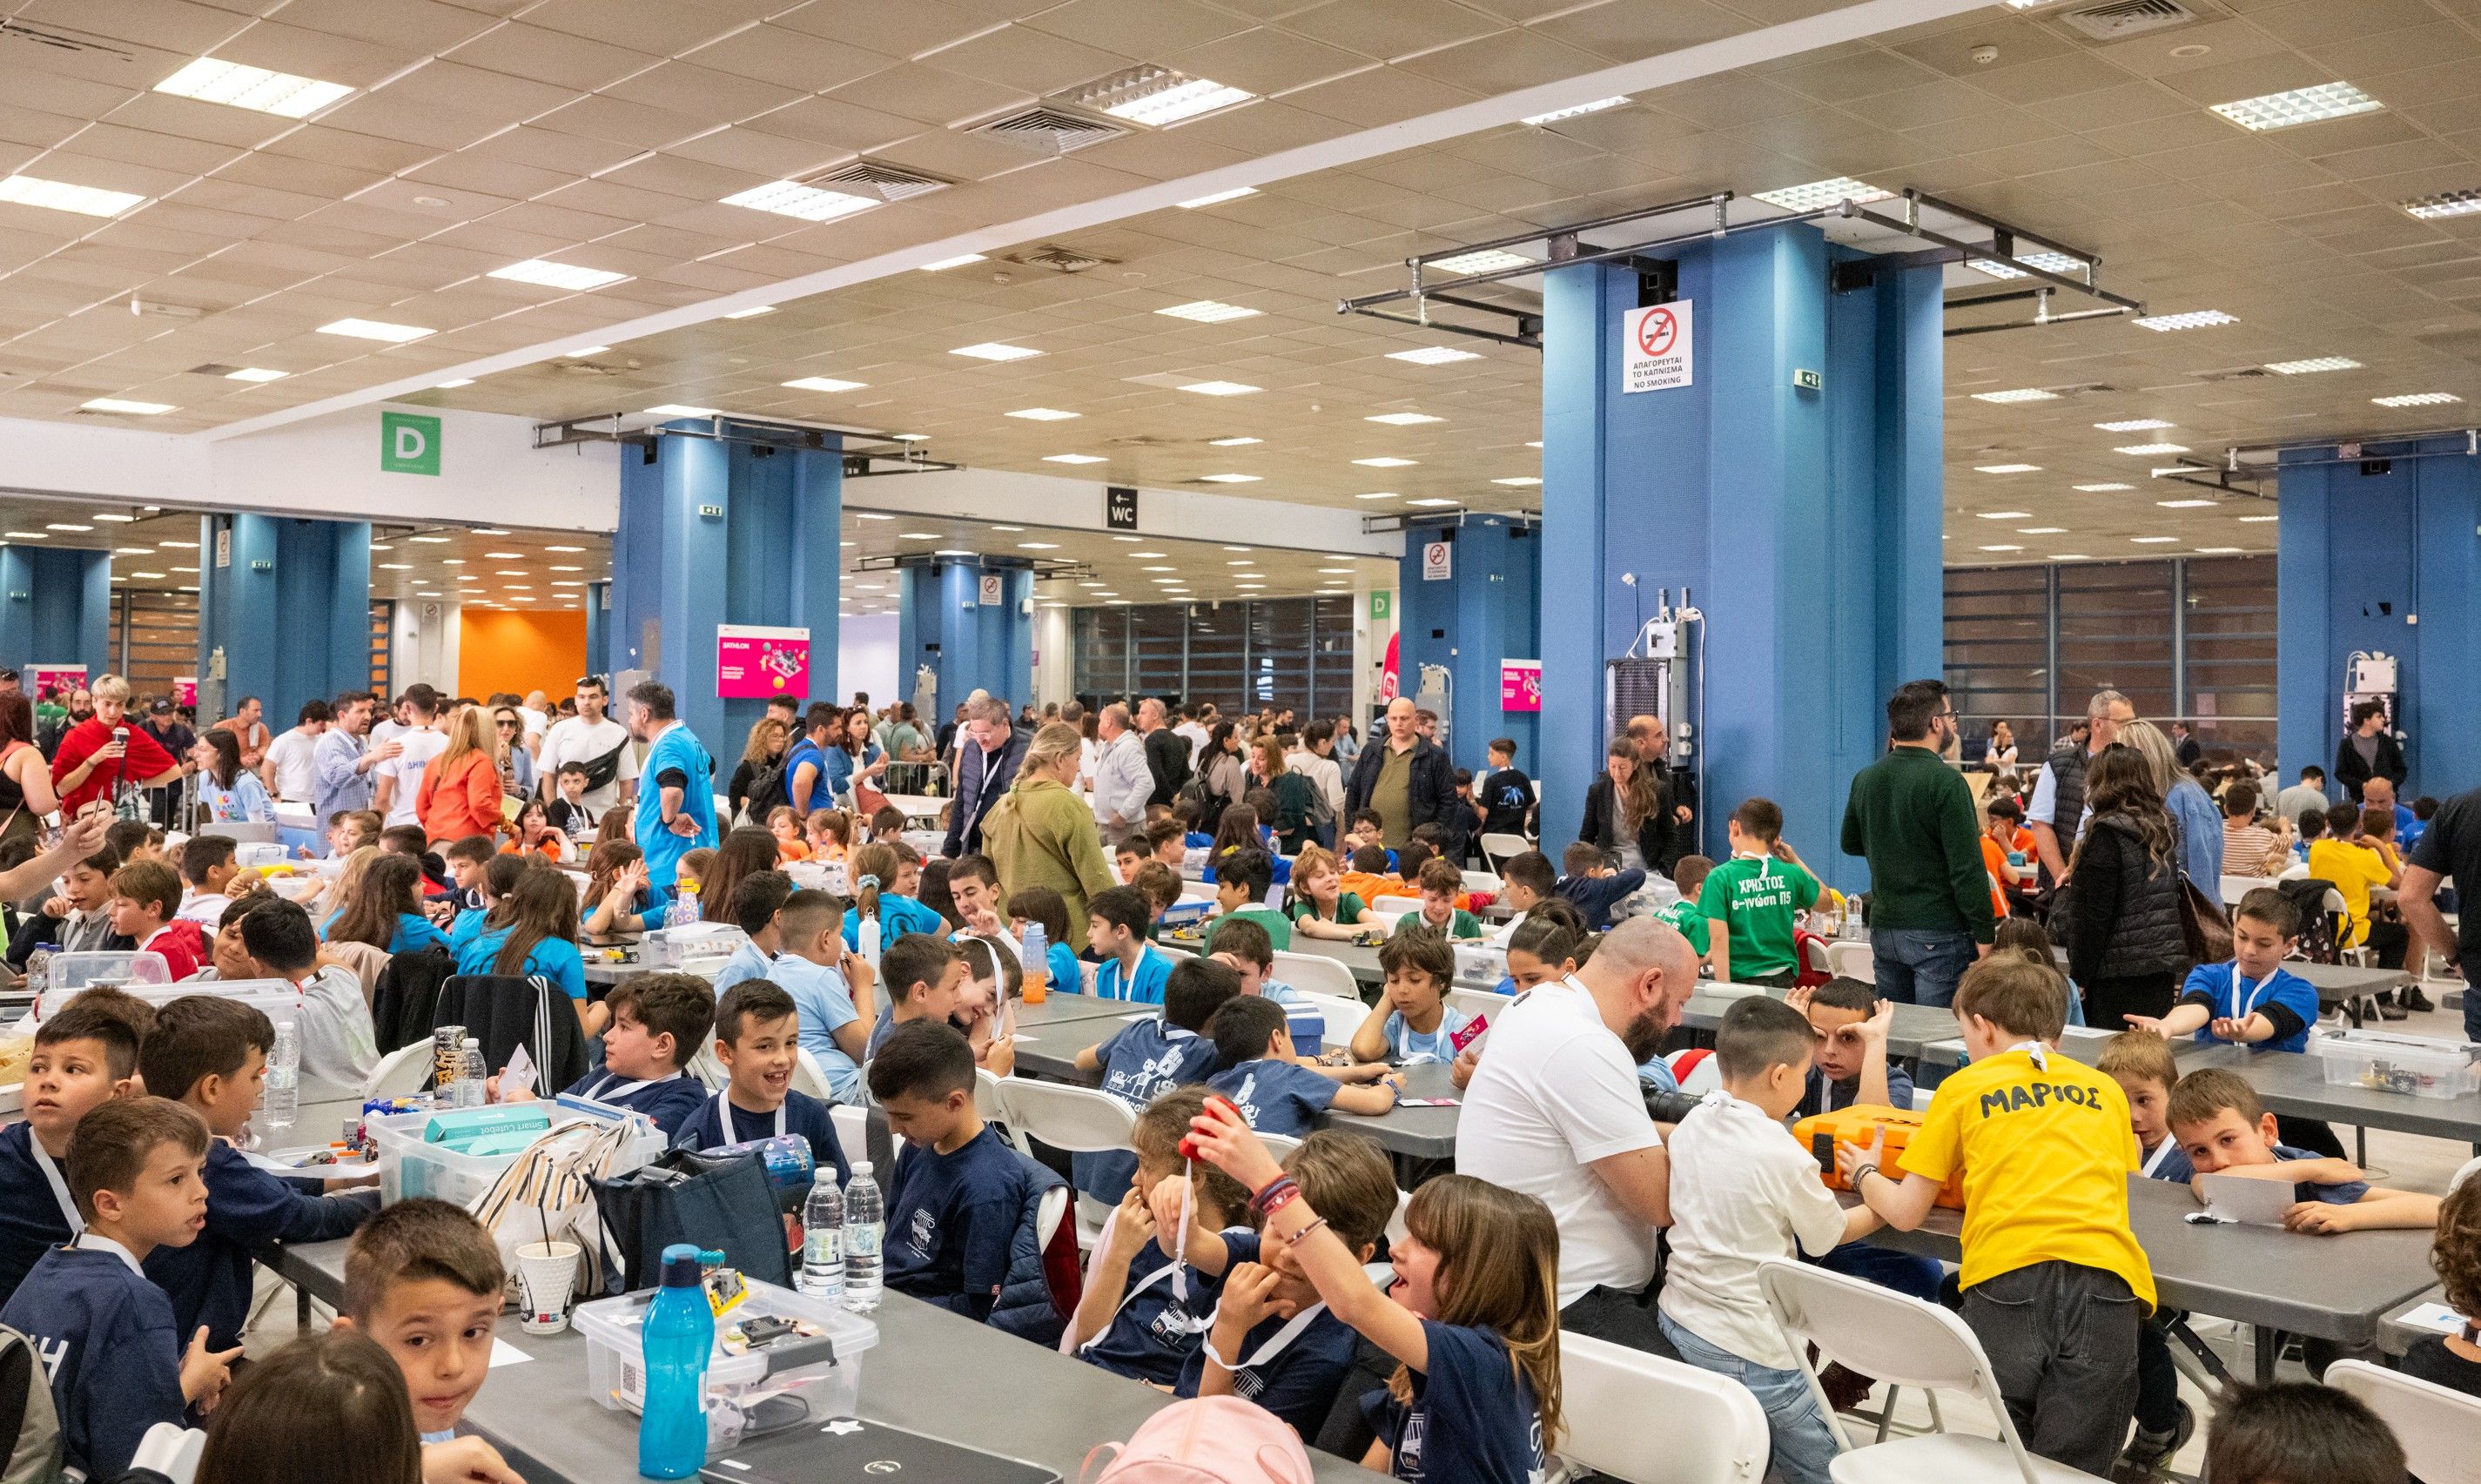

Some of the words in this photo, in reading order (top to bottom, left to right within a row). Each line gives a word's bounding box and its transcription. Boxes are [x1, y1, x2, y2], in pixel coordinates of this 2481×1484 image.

[1633, 356, 1682, 370] ΑΠΑΓΟΡΕΥΤΑΙ
[1644, 365, 1683, 377] ΚΑΠΝΙΣΜΑ
[1647, 376, 1681, 387] SMOKING
[395, 426, 426, 460] D
[1111, 506, 1133, 522] WC
[1375, 597, 1386, 613] D
[1738, 875, 1786, 895] ΧΡΗΣΤΟΣ
[1779, 890, 1792, 905] Π5
[1980, 1082, 2102, 1119] ΜΑΡΙΟΣ
[481, 1124, 515, 1135] Cutebot
[518, 1120, 544, 1131] Smart
